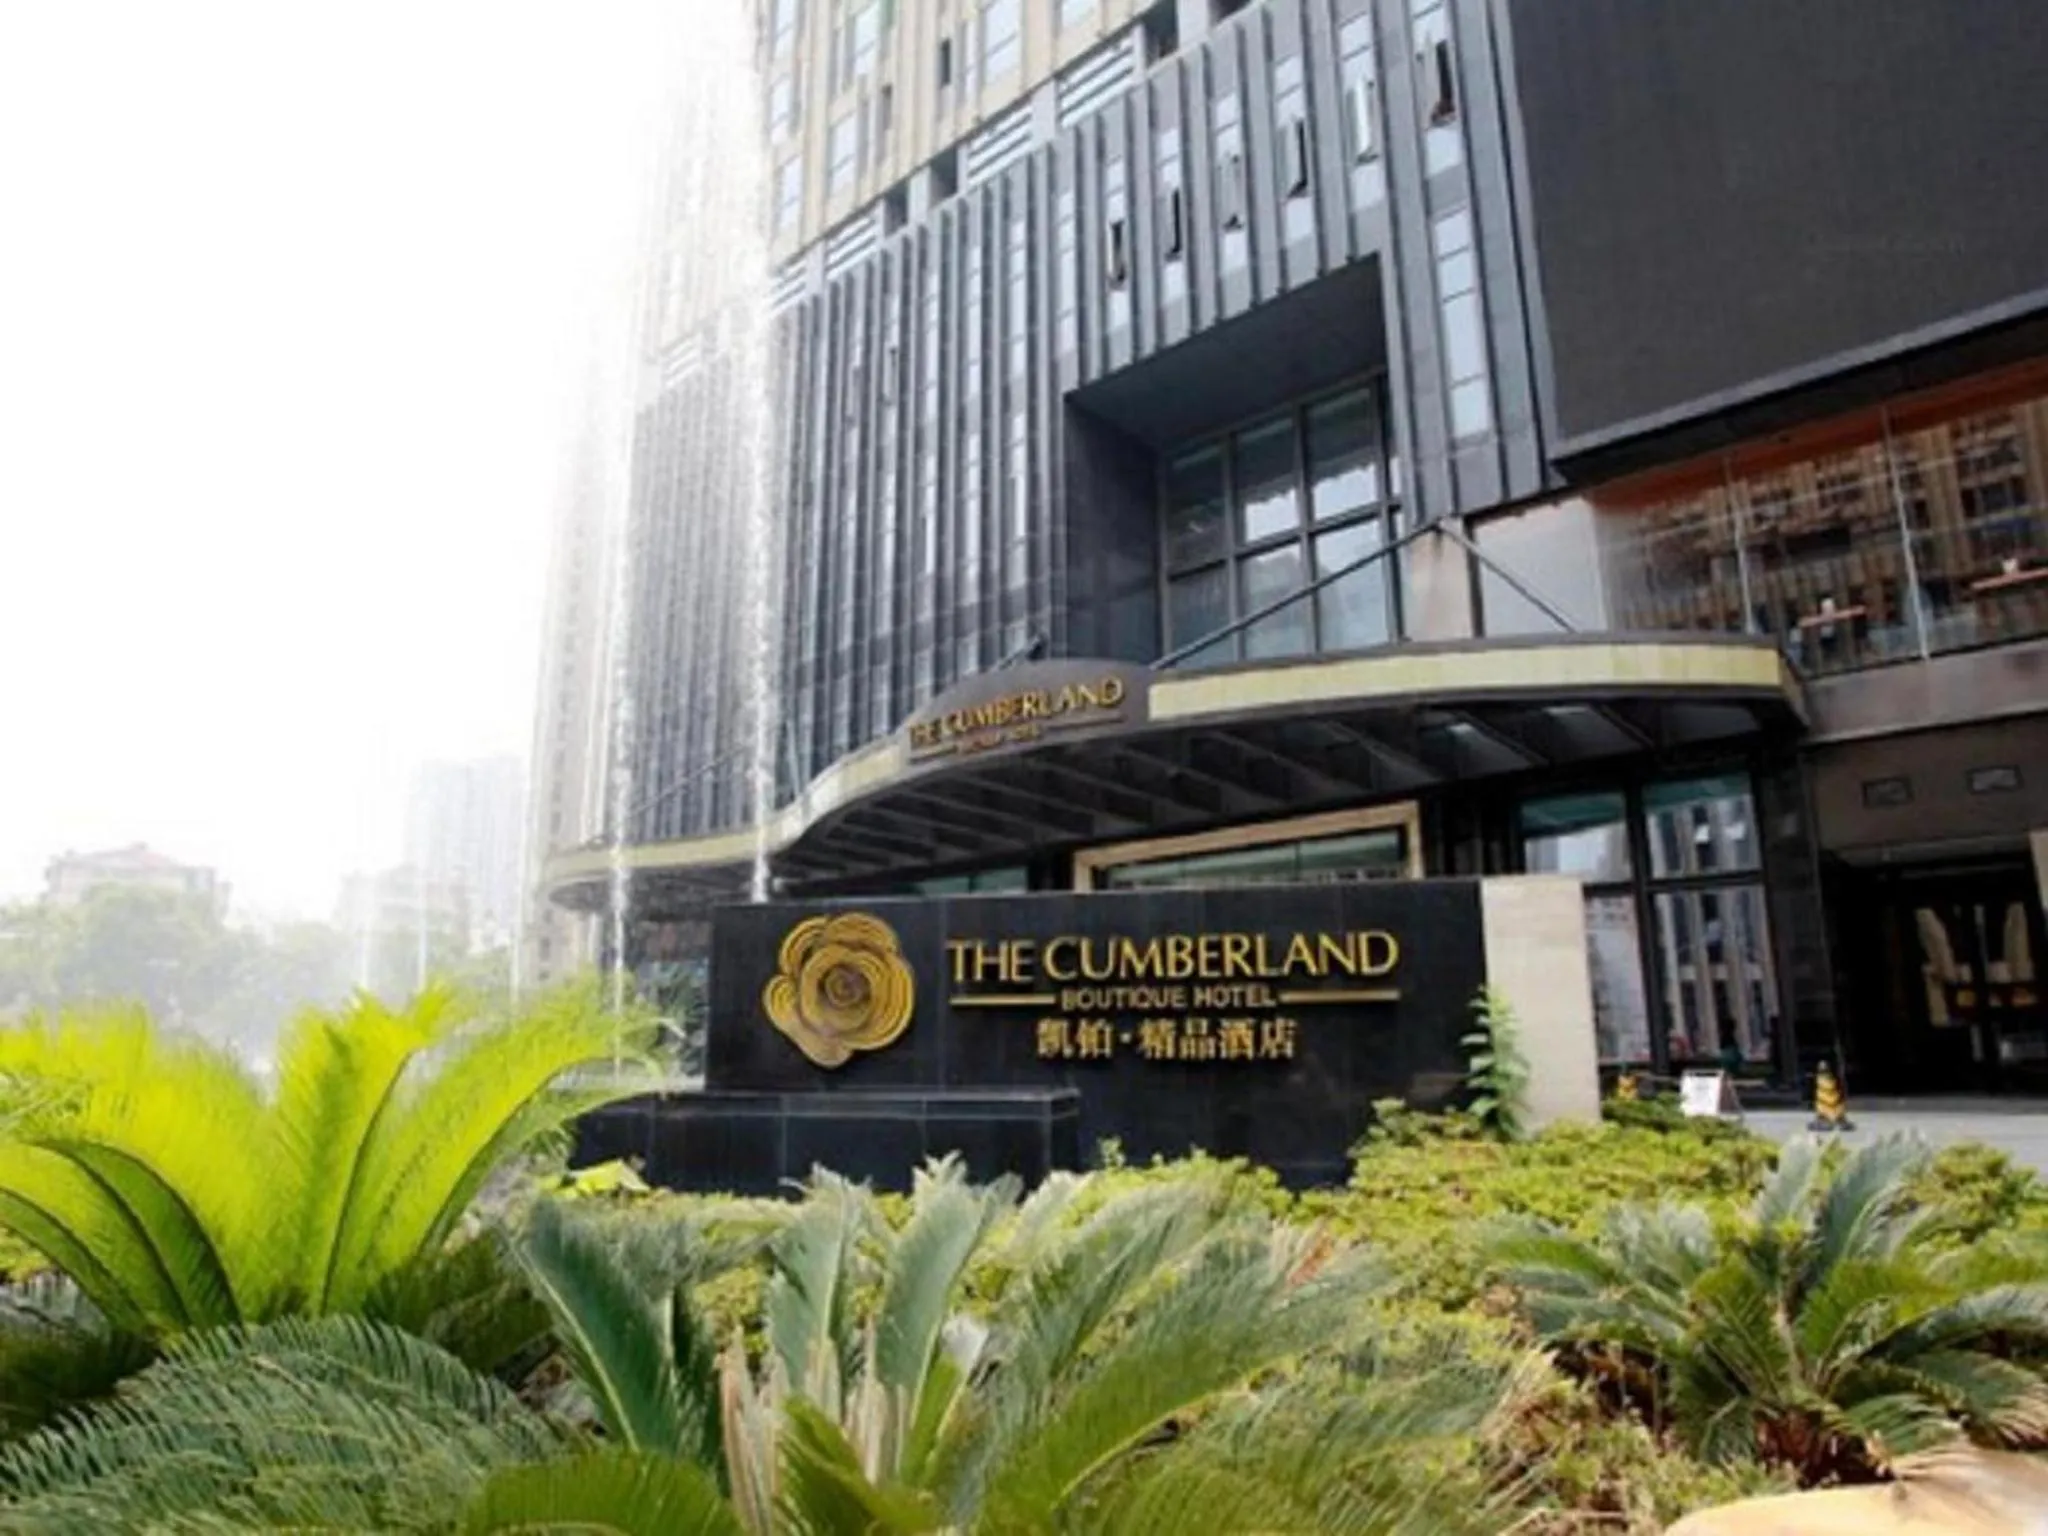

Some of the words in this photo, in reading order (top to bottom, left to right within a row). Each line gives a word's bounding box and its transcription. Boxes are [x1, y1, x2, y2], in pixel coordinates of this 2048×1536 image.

[940, 676, 1125, 735] CUMBERLAND
[946, 939, 1035, 983] THE
[1044, 930, 1399, 981] CUMBERLAND
[1061, 987, 1188, 1011] BOUTIQUE
[1193, 984, 1277, 1008] HOTEL
